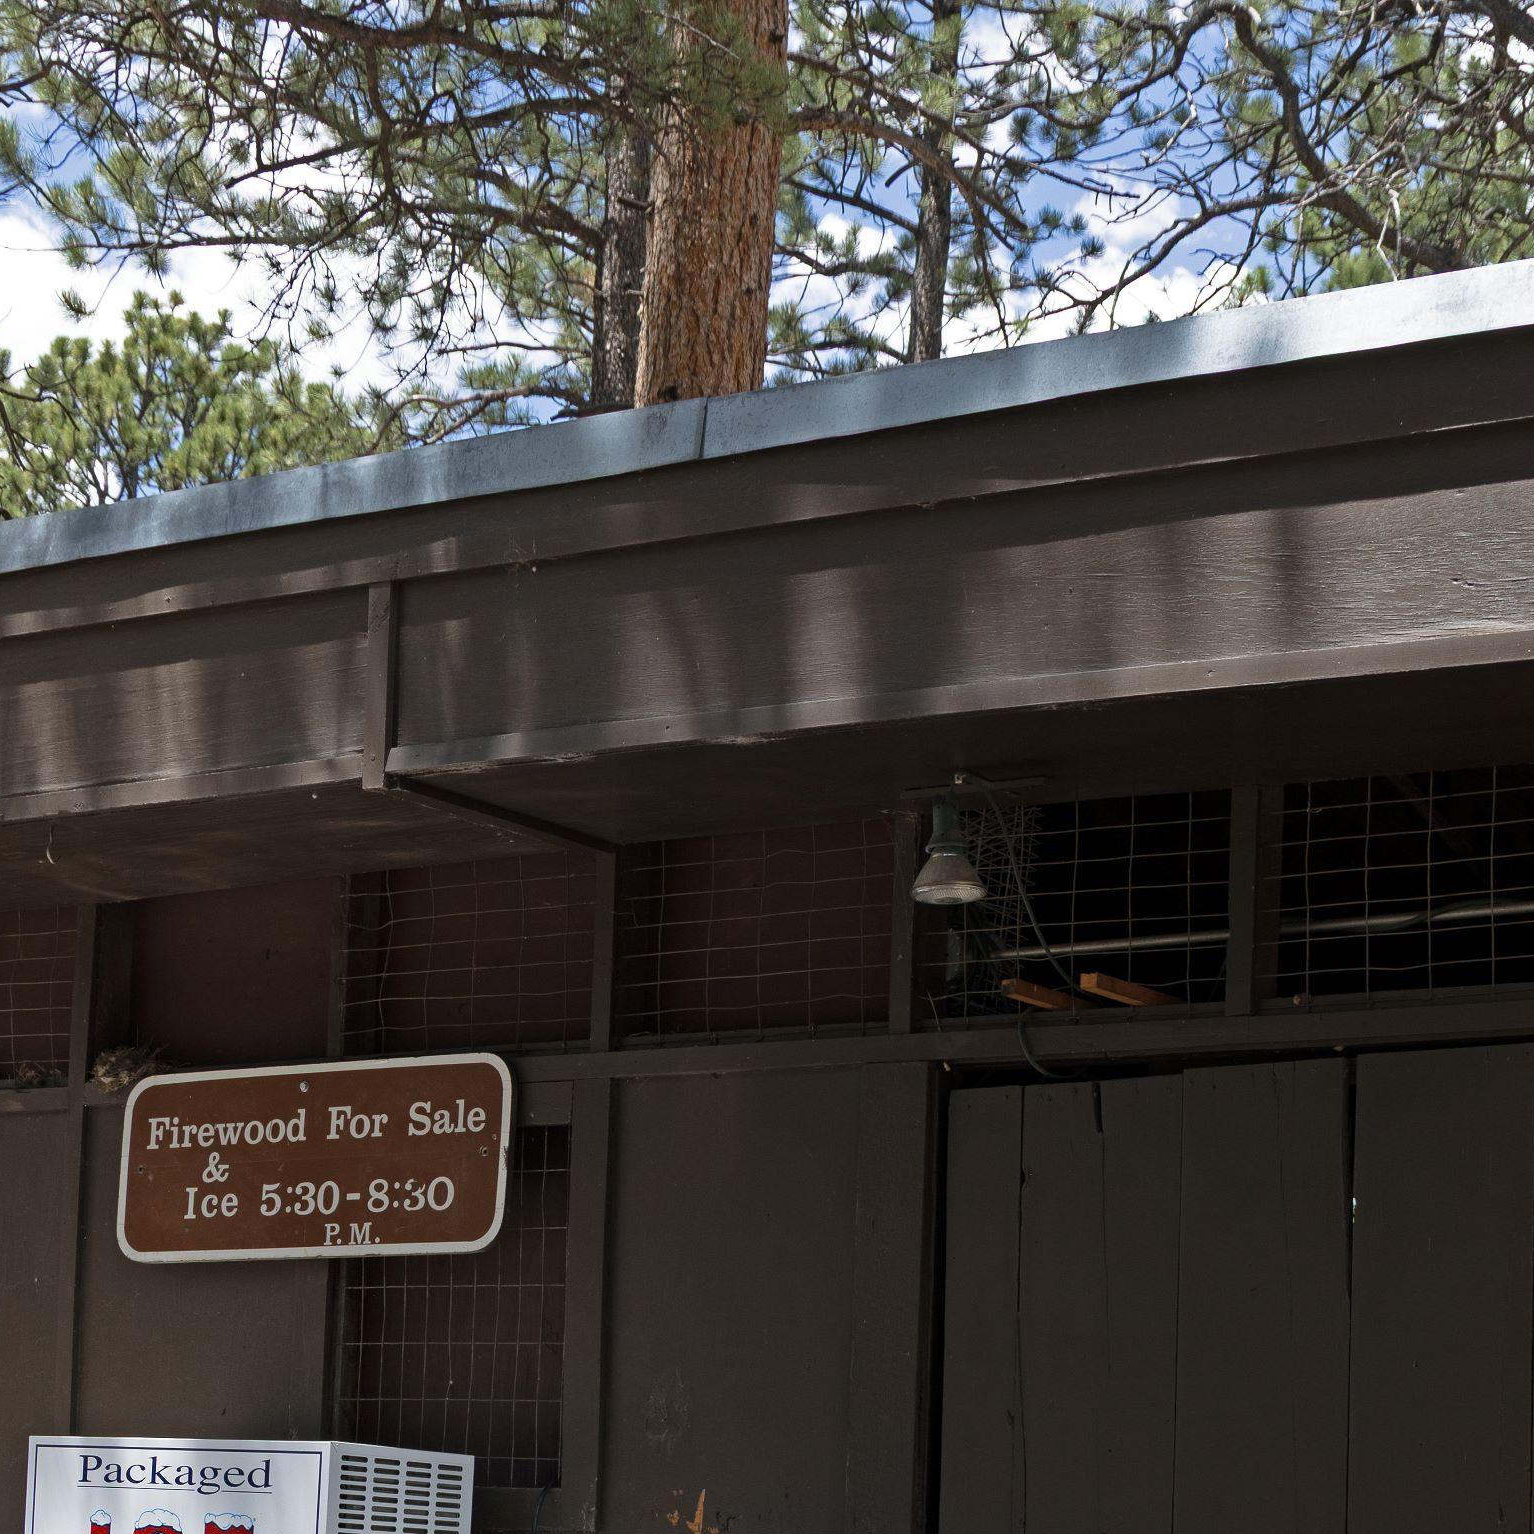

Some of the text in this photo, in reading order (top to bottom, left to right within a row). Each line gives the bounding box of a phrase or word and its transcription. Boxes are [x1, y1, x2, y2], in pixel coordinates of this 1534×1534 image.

[146, 1099, 487, 1150] Firewood For Sale
[201, 1151, 230, 1184] &
[183, 1175, 456, 1220] Ice 5:30-8:30
[77, 1454, 273, 1495] Packaged
